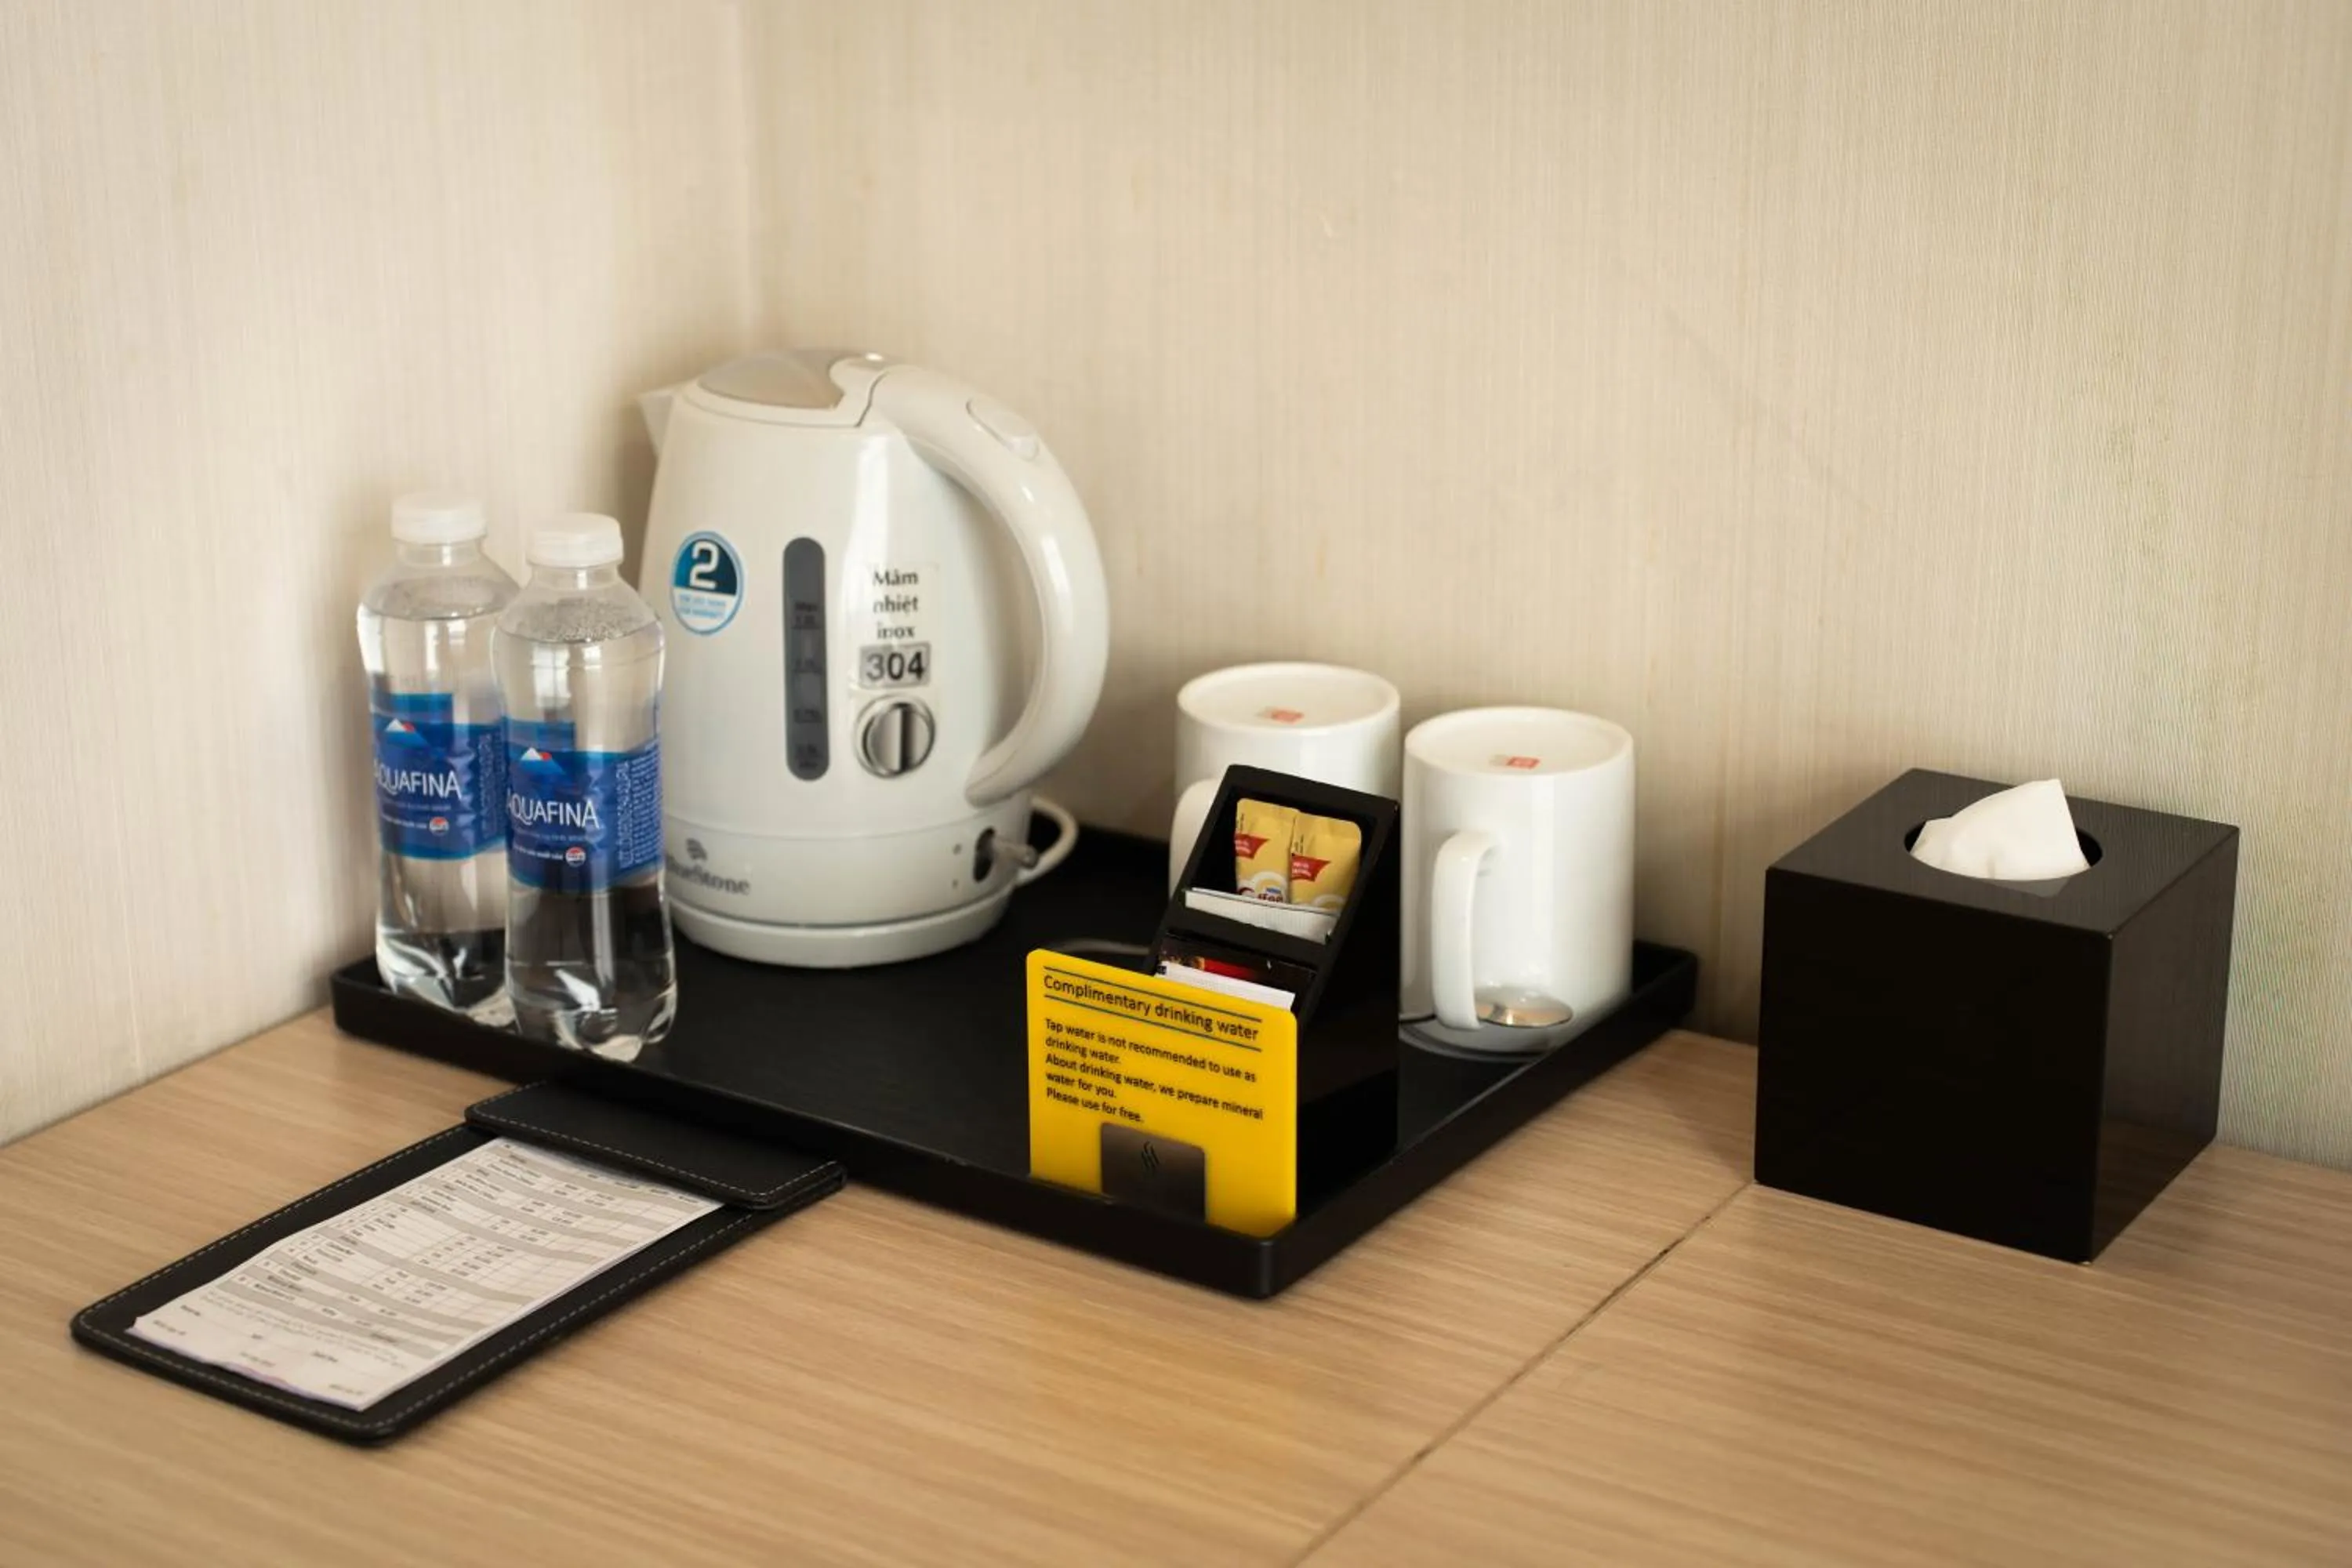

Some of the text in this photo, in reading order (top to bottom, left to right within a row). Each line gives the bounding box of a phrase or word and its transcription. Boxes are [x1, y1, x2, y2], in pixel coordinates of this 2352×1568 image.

[690, 541, 720, 590] 2
[877, 622, 916, 639] inox
[866, 651, 924, 681] 304
[1044, 975, 1259, 1040] Complimentary drinking water
[1045, 1036, 1087, 1058] drinking
[1046, 1018, 1257, 1083] Tap water is not recommended to use as
[1046, 1073, 1116, 1098] water for you.
[1046, 1053, 1077, 1069] About
[1080, 1063, 1122, 1084] drinking
[1159, 1084, 1175, 1097] we
[1178, 1090, 1219, 1108] prepare
[1221, 1102, 1263, 1120] mineral
[1047, 1087, 1144, 1123] Please use for free.
